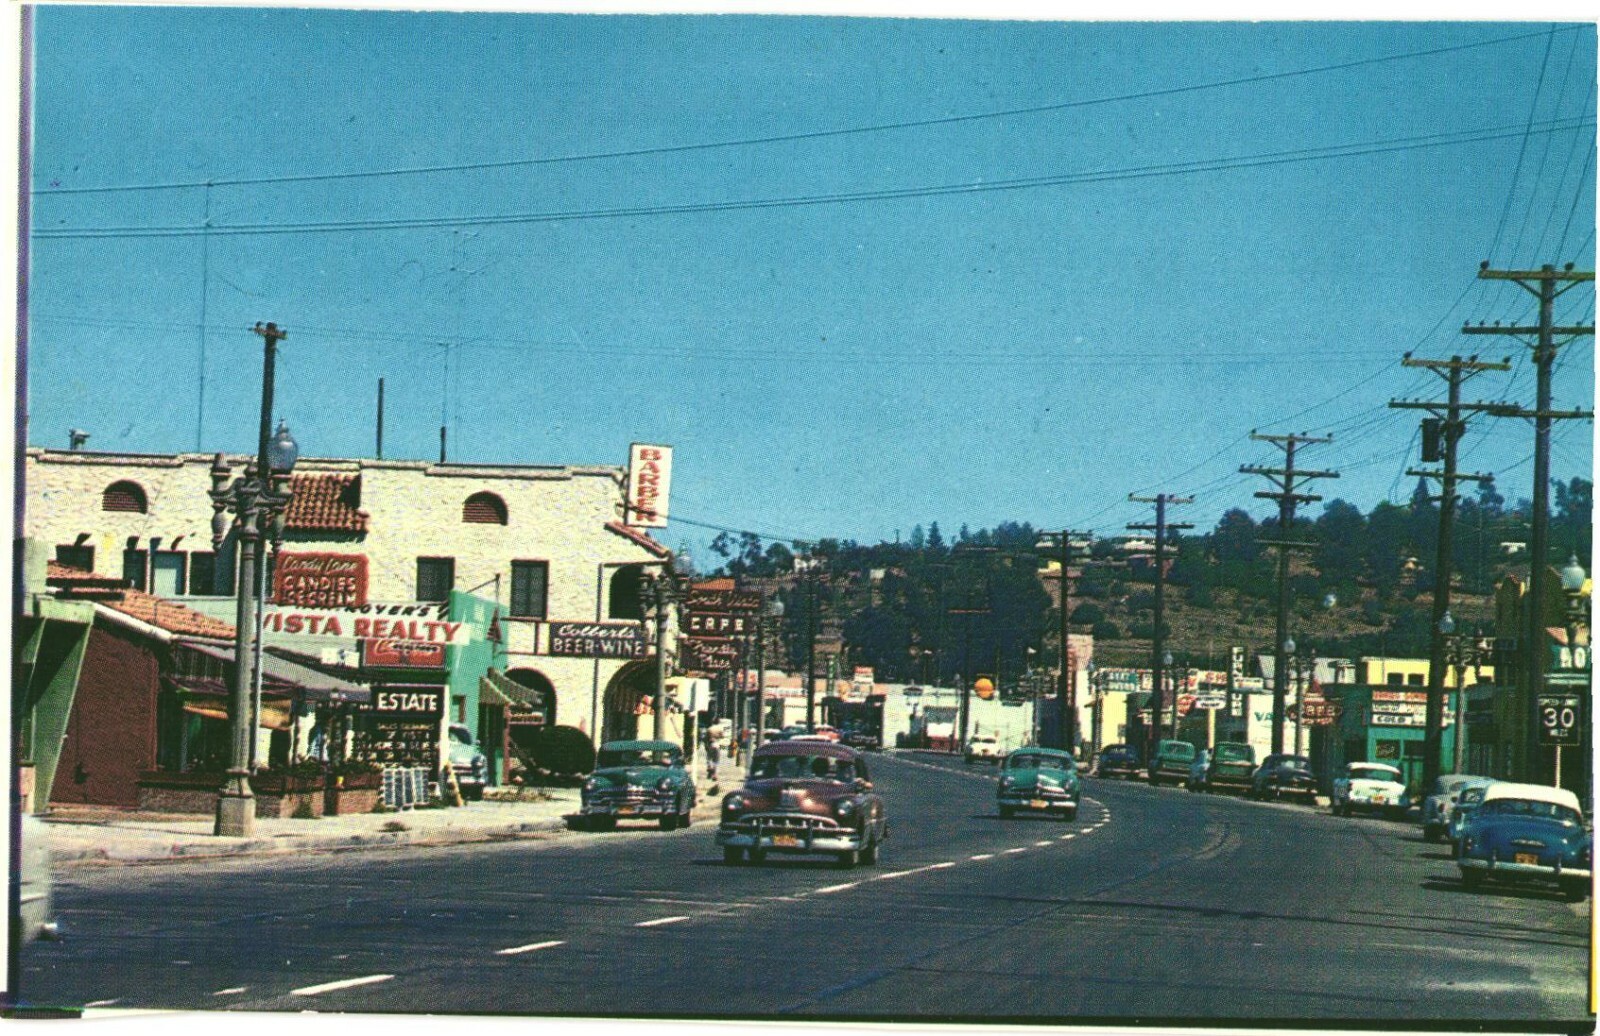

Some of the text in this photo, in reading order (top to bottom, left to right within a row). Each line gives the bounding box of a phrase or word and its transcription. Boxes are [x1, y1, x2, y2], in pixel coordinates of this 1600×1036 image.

[636, 449, 661, 522] BARBER
[282, 556, 358, 575] Candy Lane
[282, 575, 356, 592] CANDIES
[353, 618, 462, 641] REALTY
[690, 617, 744, 631] CAFE
[377, 691, 439, 711] ESTATE
[1544, 707, 1574, 728] 30
